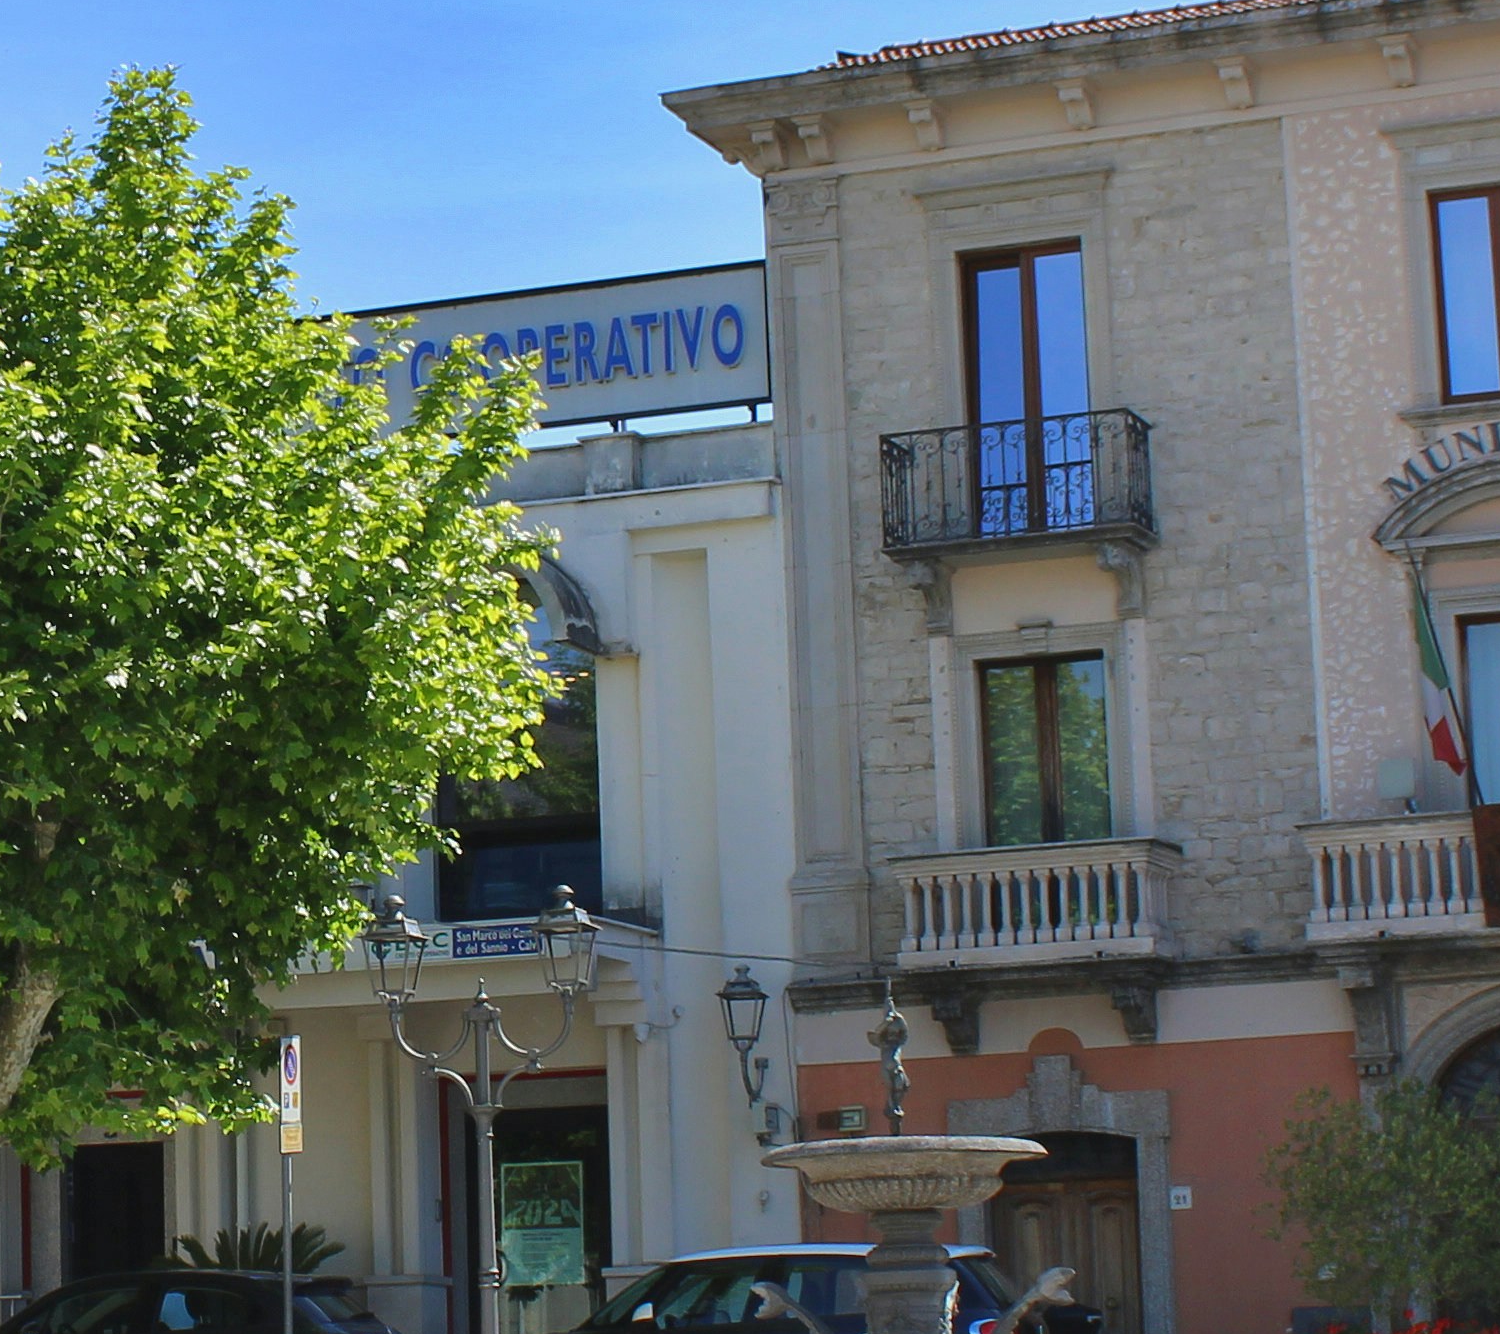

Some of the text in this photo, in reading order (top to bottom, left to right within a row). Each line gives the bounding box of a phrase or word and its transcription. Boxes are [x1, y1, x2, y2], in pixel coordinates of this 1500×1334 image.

[411, 303, 746, 397] COPERATIVO
[456, 930, 472, 943] San
[472, 929, 498, 942] Marco
[518, 939, 537, 951] Calv
